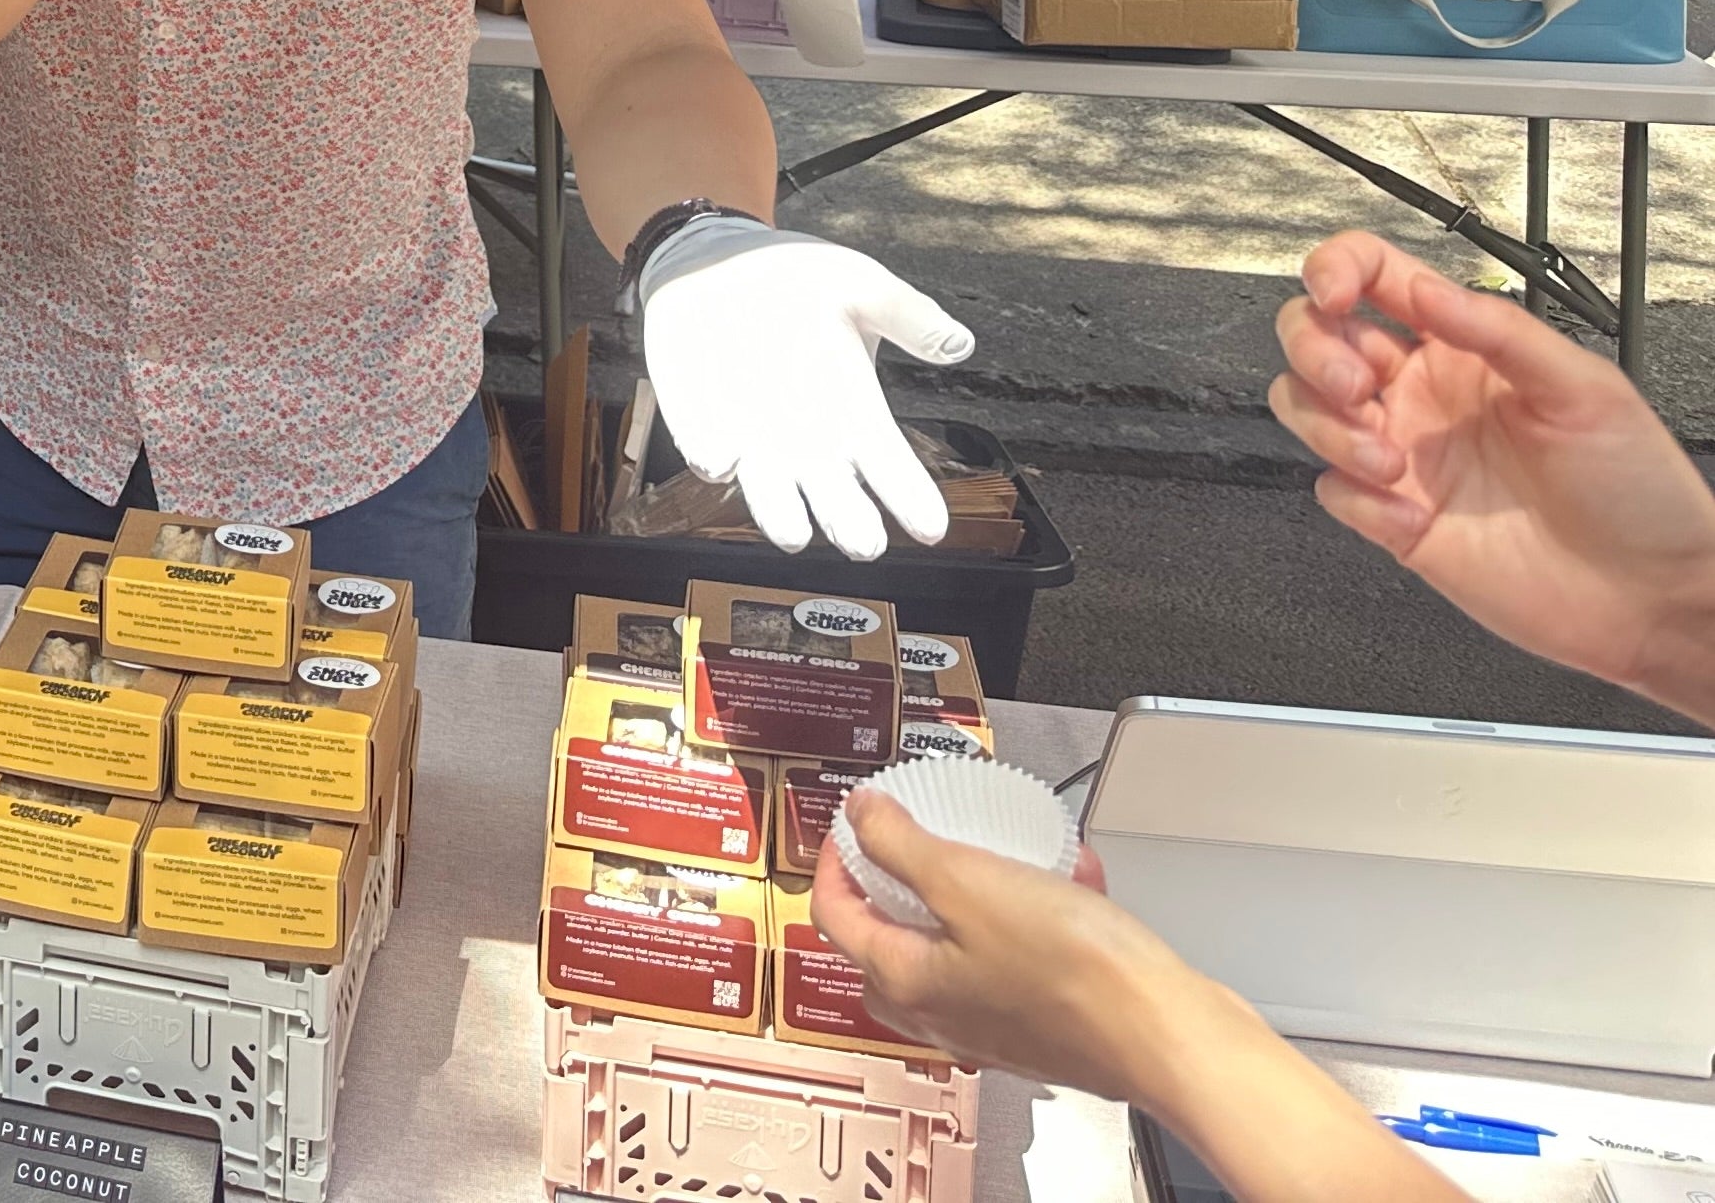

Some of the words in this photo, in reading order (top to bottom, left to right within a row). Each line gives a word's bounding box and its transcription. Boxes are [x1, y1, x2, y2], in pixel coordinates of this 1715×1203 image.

[224, 539, 279, 552] CUBES
[226, 532, 283, 548] SNOW
[326, 596, 382, 610] CUBES
[330, 588, 385, 603] SNOW
[804, 619, 868, 633] CUBES
[806, 611, 868, 629] SNOW
[729, 648, 804, 664] CHERRY
[808, 657, 860, 672] OREO
[900, 648, 947, 663] NOW
[900, 654, 946, 668] UBES
[307, 674, 366, 686] CUBES
[312, 666, 370, 681] SNOW
[207, 836, 284, 854] PINEAPPLE
[209, 844, 278, 860] COCONUT
[1, 1121, 144, 1165] PINEAPPLE
[17, 1162, 128, 1200] COCONUT
